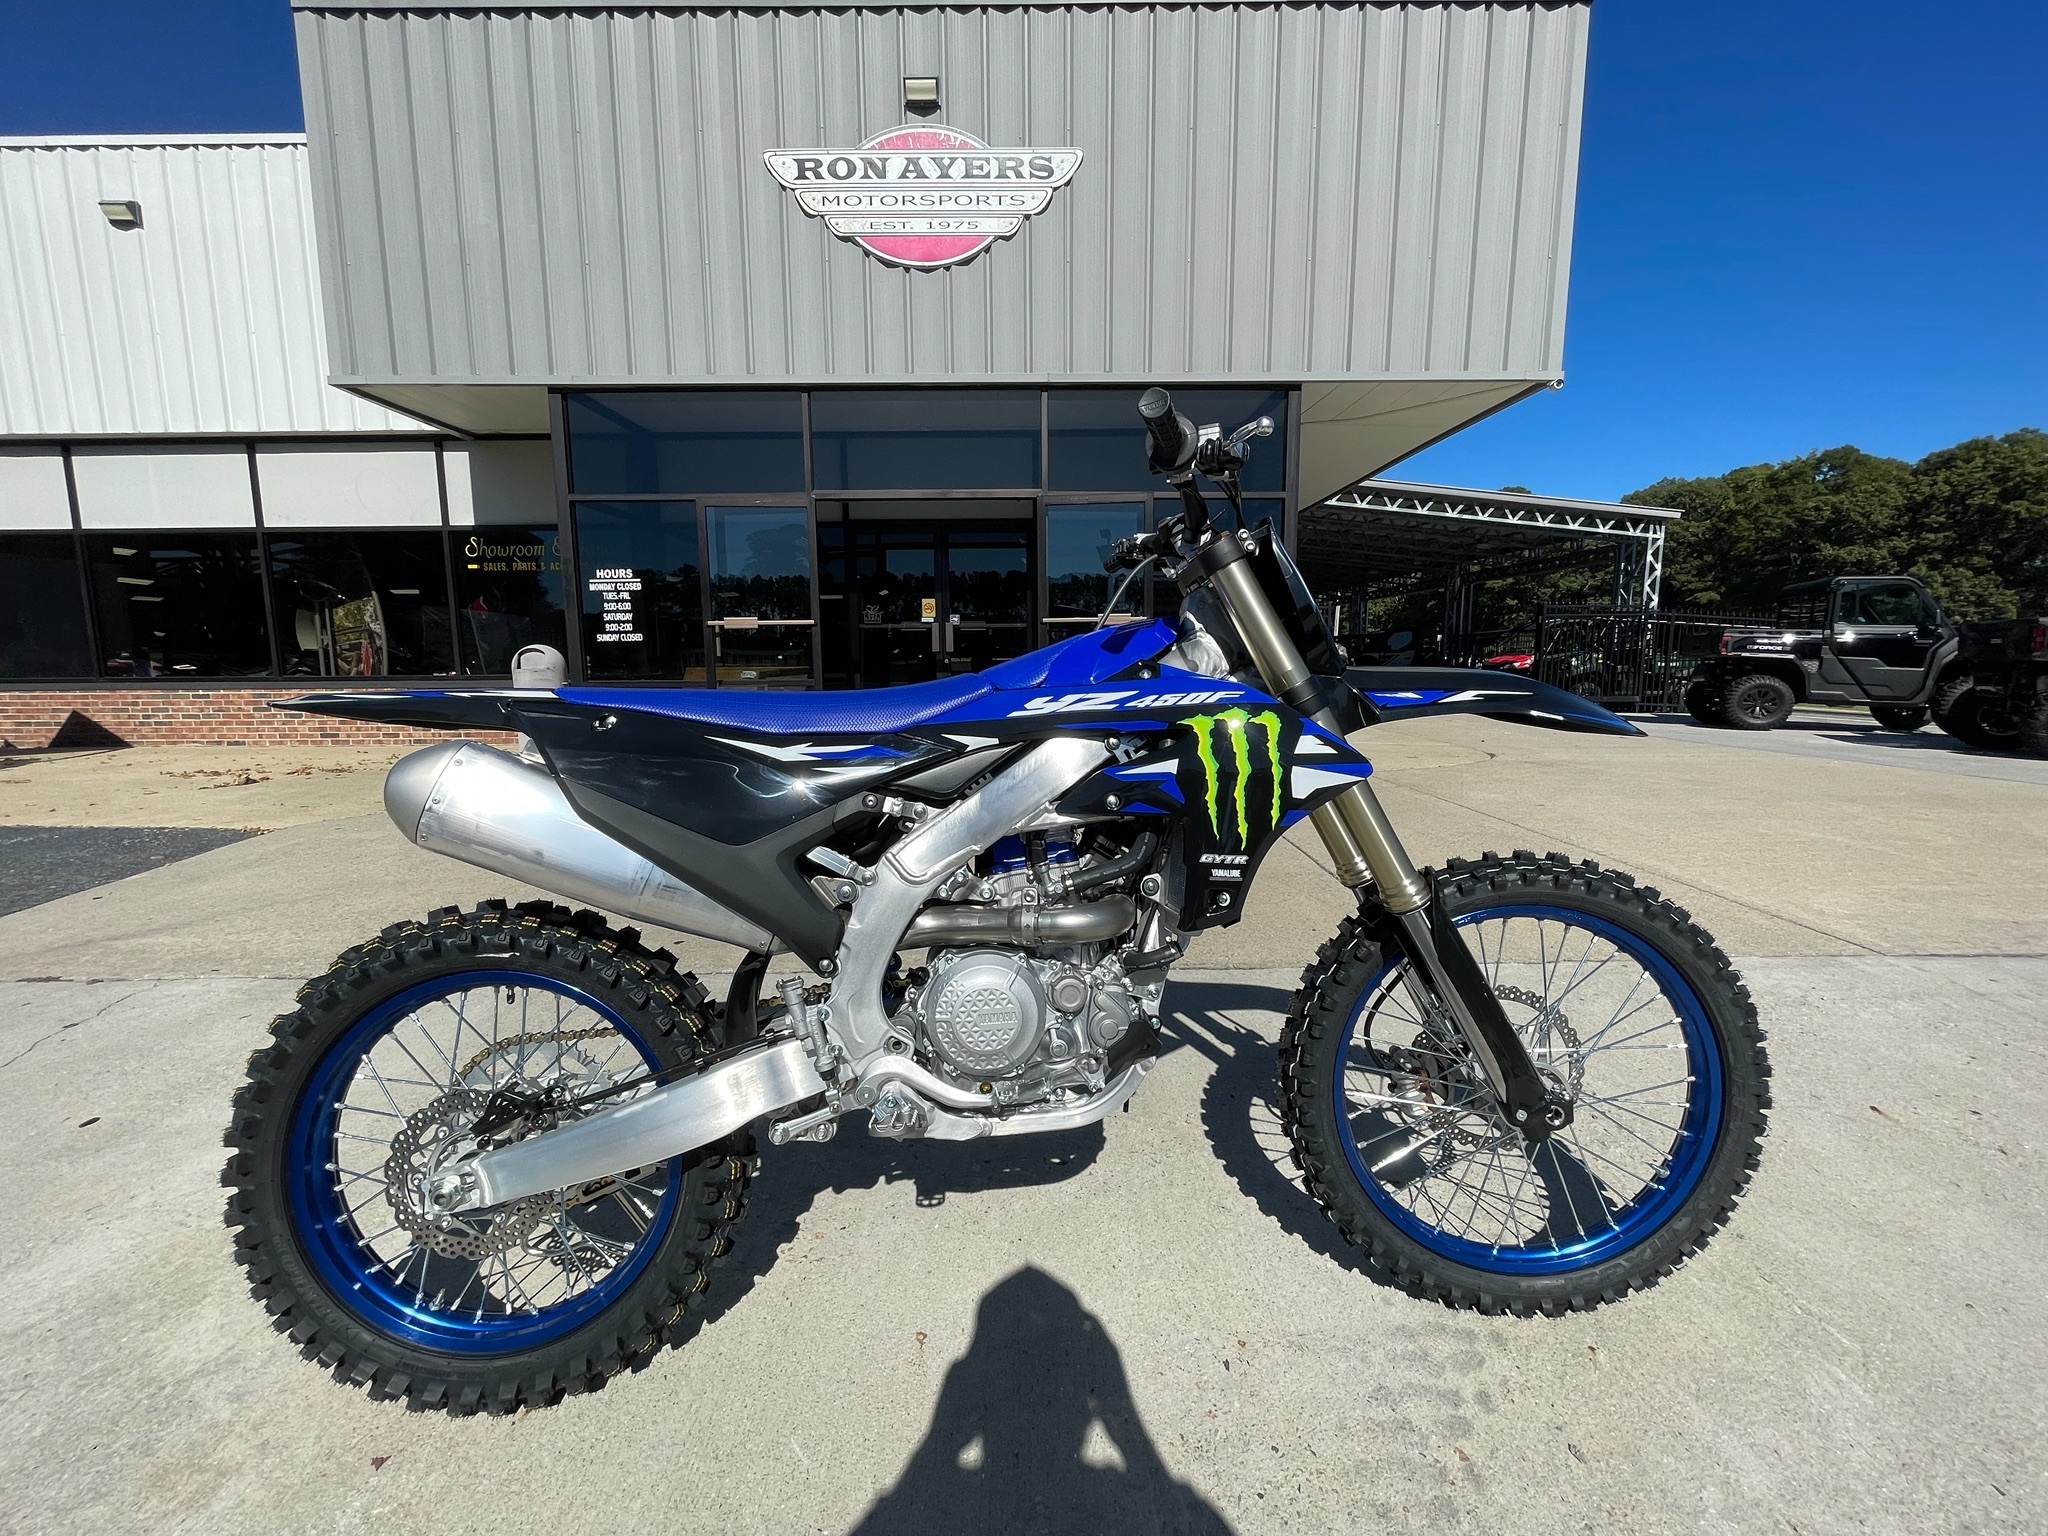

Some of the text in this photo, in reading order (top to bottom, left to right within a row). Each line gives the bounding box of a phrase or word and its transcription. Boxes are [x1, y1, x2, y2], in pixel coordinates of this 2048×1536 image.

[793, 156, 1055, 181] RON AYERS
[822, 194, 1026, 207] MOTORSPORTS
[869, 220, 979, 231] EST. 1975
[465, 536, 545, 558] Showroom
[483, 562, 510, 572] SALES,
[512, 562, 537, 571] PARTS
[596, 568, 633, 579] HOURS
[589, 582, 642, 591] MONDAY CLOSED
[603, 612, 633, 621] SATURDAY
[596, 633, 643, 642] SUNDAY CLOSED
[1006, 690, 1245, 718] YZ 450F
[1199, 853, 1250, 865] GYTR
[1211, 868, 1241, 878] YAMALUBE
[978, 1011, 1018, 1026] YAMAHA
